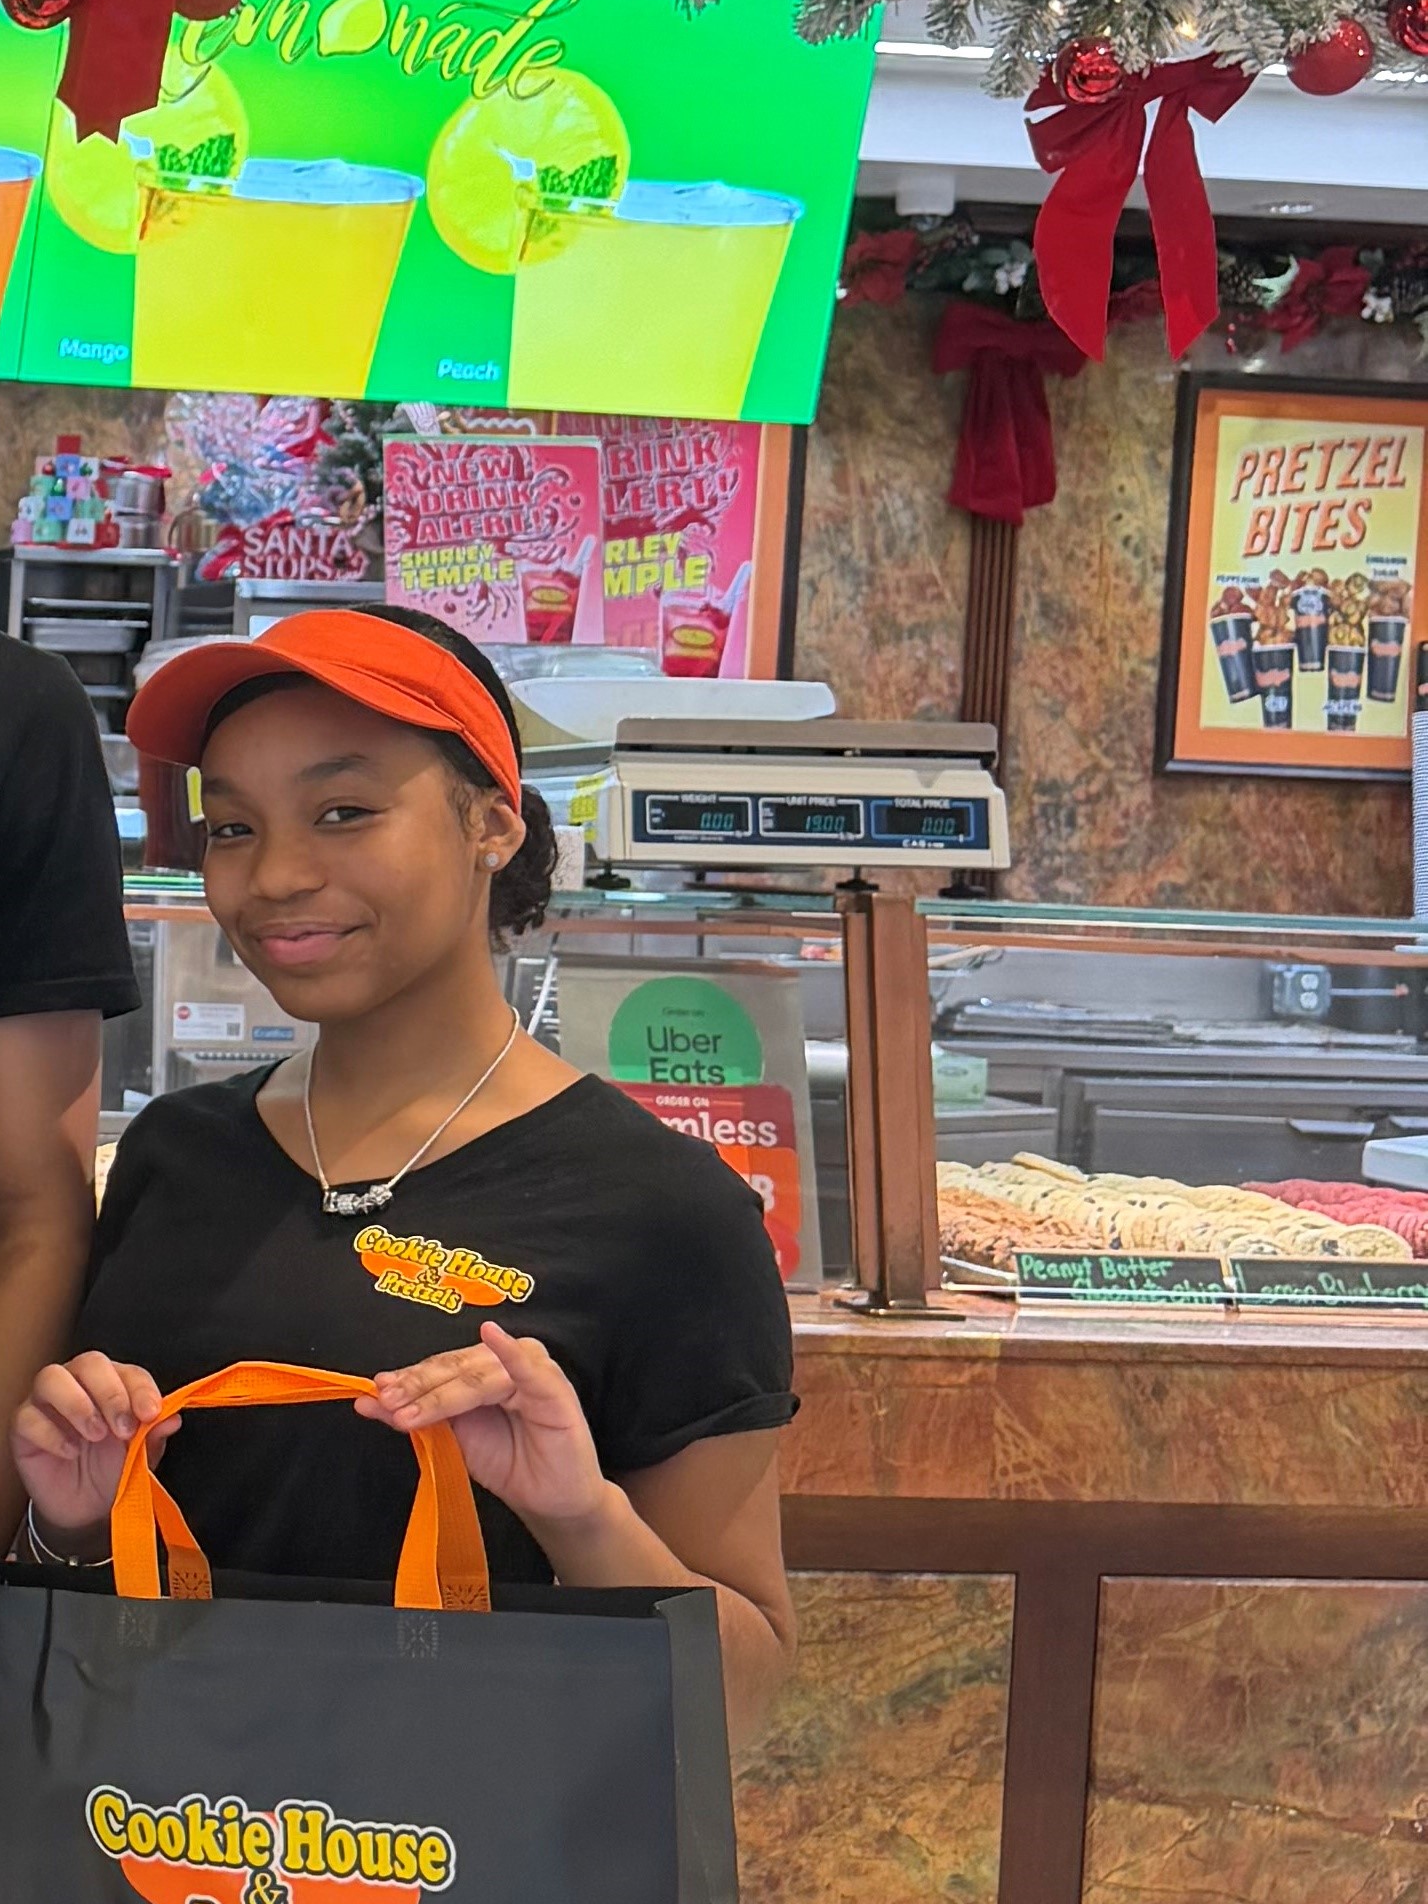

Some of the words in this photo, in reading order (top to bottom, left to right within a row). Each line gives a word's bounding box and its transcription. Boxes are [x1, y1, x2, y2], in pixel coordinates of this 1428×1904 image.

[59, 337, 130, 364] Mango
[437, 358, 501, 381] Peach
[430, 456, 513, 485] NEW
[1230, 436, 1407, 502] PRETZEL
[419, 482, 532, 515] DRINK
[243, 524, 353, 558] SANTA
[1242, 498, 1372, 559] BITES
[401, 544, 495, 569] SHIRLEY
[605, 531, 683, 566] RLEY
[401, 560, 515, 590] TEMPLE
[604, 556, 710, 598] MPLE
[646, 1026, 722, 1054] Uber
[649, 1056, 726, 1085] Eats
[656, 1095, 690, 1107] ORDER
[692, 1096, 710, 1108] ON
[357, 1226, 447, 1268] Cookie
[446, 1249, 532, 1299] House
[418, 1267, 440, 1285] &
[1021, 1254, 1093, 1280] Peanut
[379, 1270, 462, 1311] Pretzels
[91, 1792, 274, 1868] Cookie
[281, 1805, 449, 1882] House
